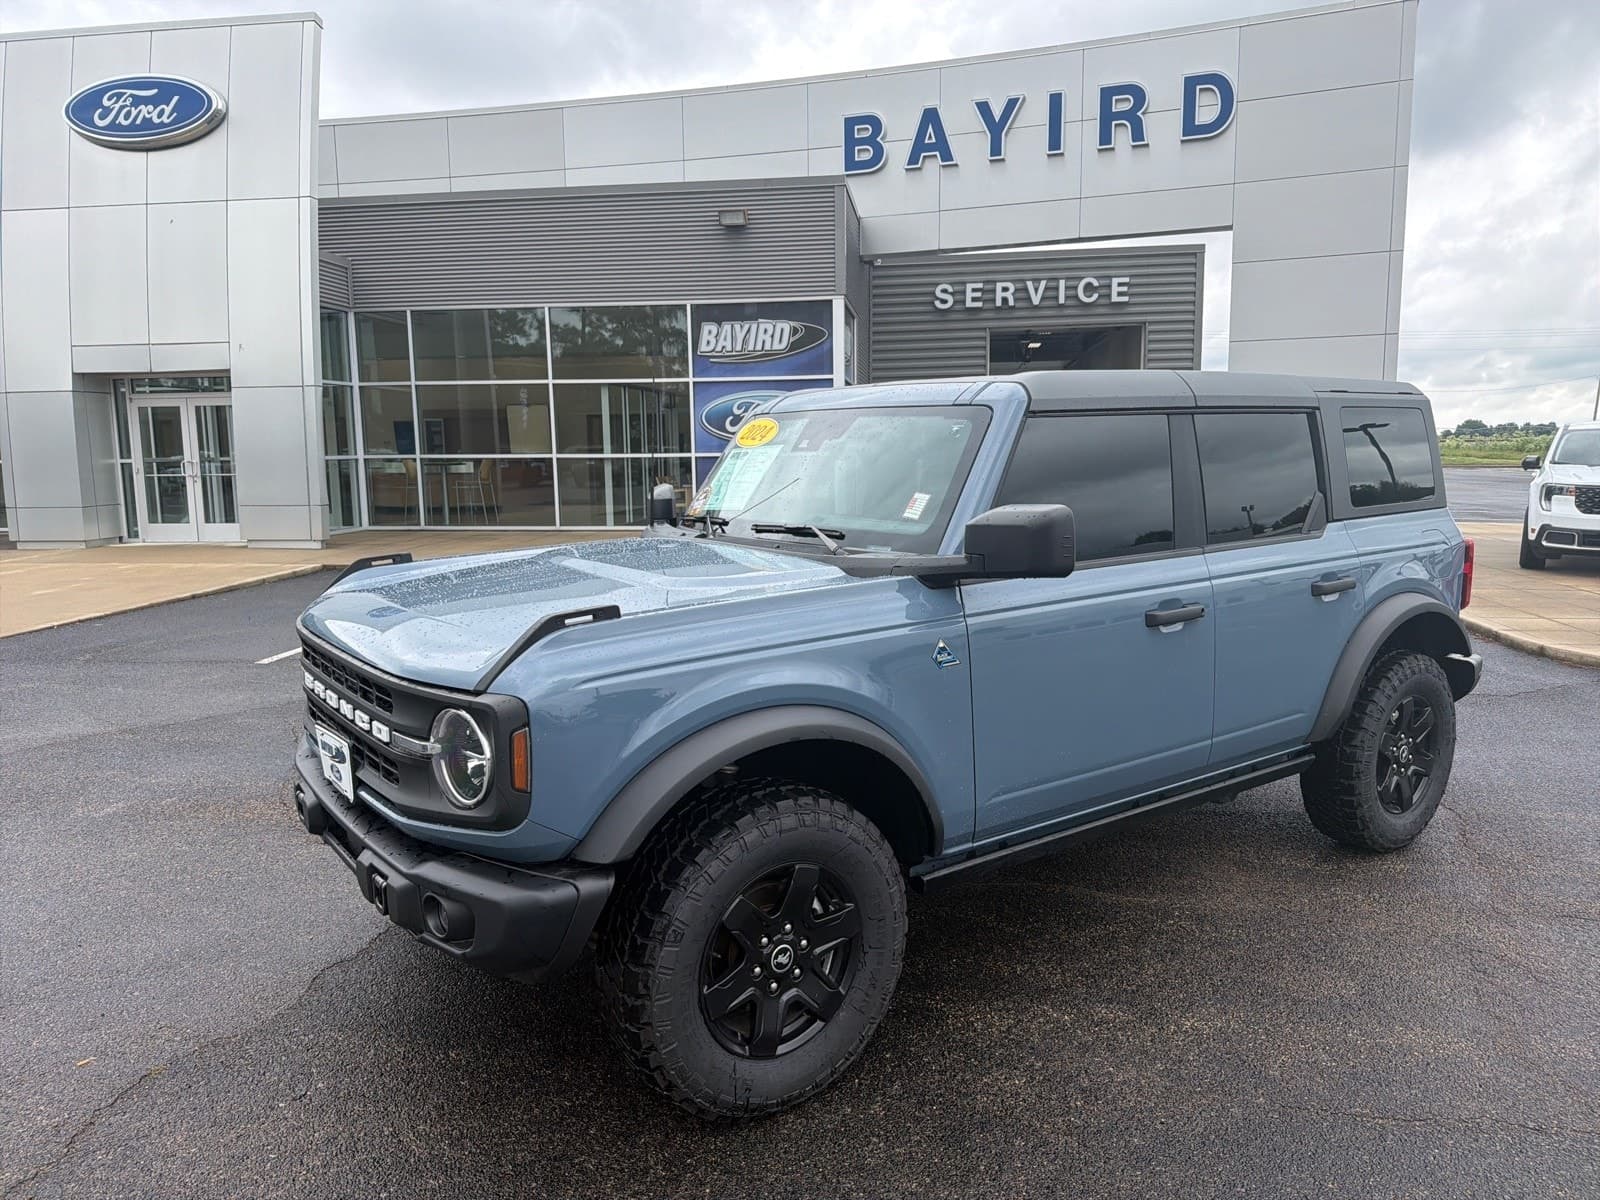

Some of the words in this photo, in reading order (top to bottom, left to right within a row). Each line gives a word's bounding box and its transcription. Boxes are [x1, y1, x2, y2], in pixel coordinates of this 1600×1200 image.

[93, 88, 180, 127] Ford
[842, 70, 1238, 174] BAYIRD
[933, 276, 1130, 310] SERVICE
[699, 321, 793, 354] BAYIRD
[739, 424, 776, 442] 2024
[304, 671, 390, 742] BRONCO
